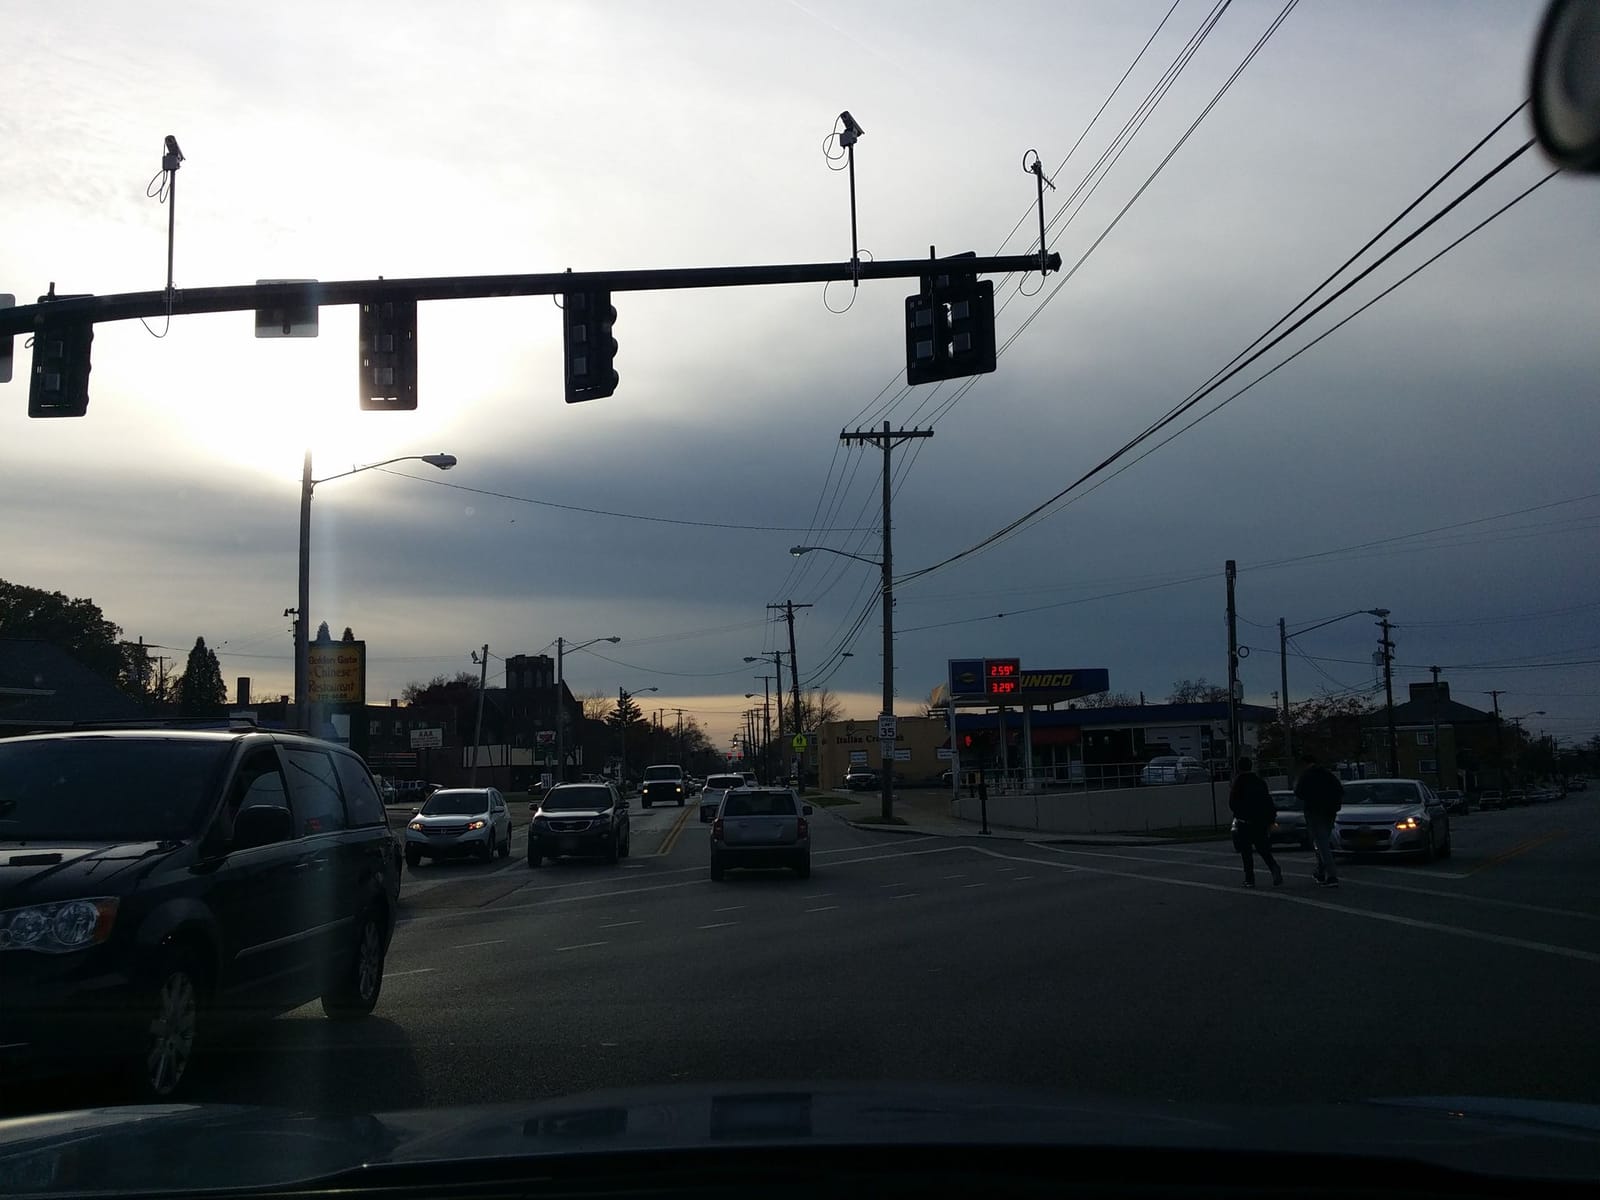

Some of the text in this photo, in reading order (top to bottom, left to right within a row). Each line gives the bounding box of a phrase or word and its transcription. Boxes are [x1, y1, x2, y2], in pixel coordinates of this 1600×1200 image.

[308, 680, 354, 692] Restaurant
[1021, 674, 1073, 687] UNOCO
[880, 727, 895, 737] 35
[836, 736, 862, 744] Italian
